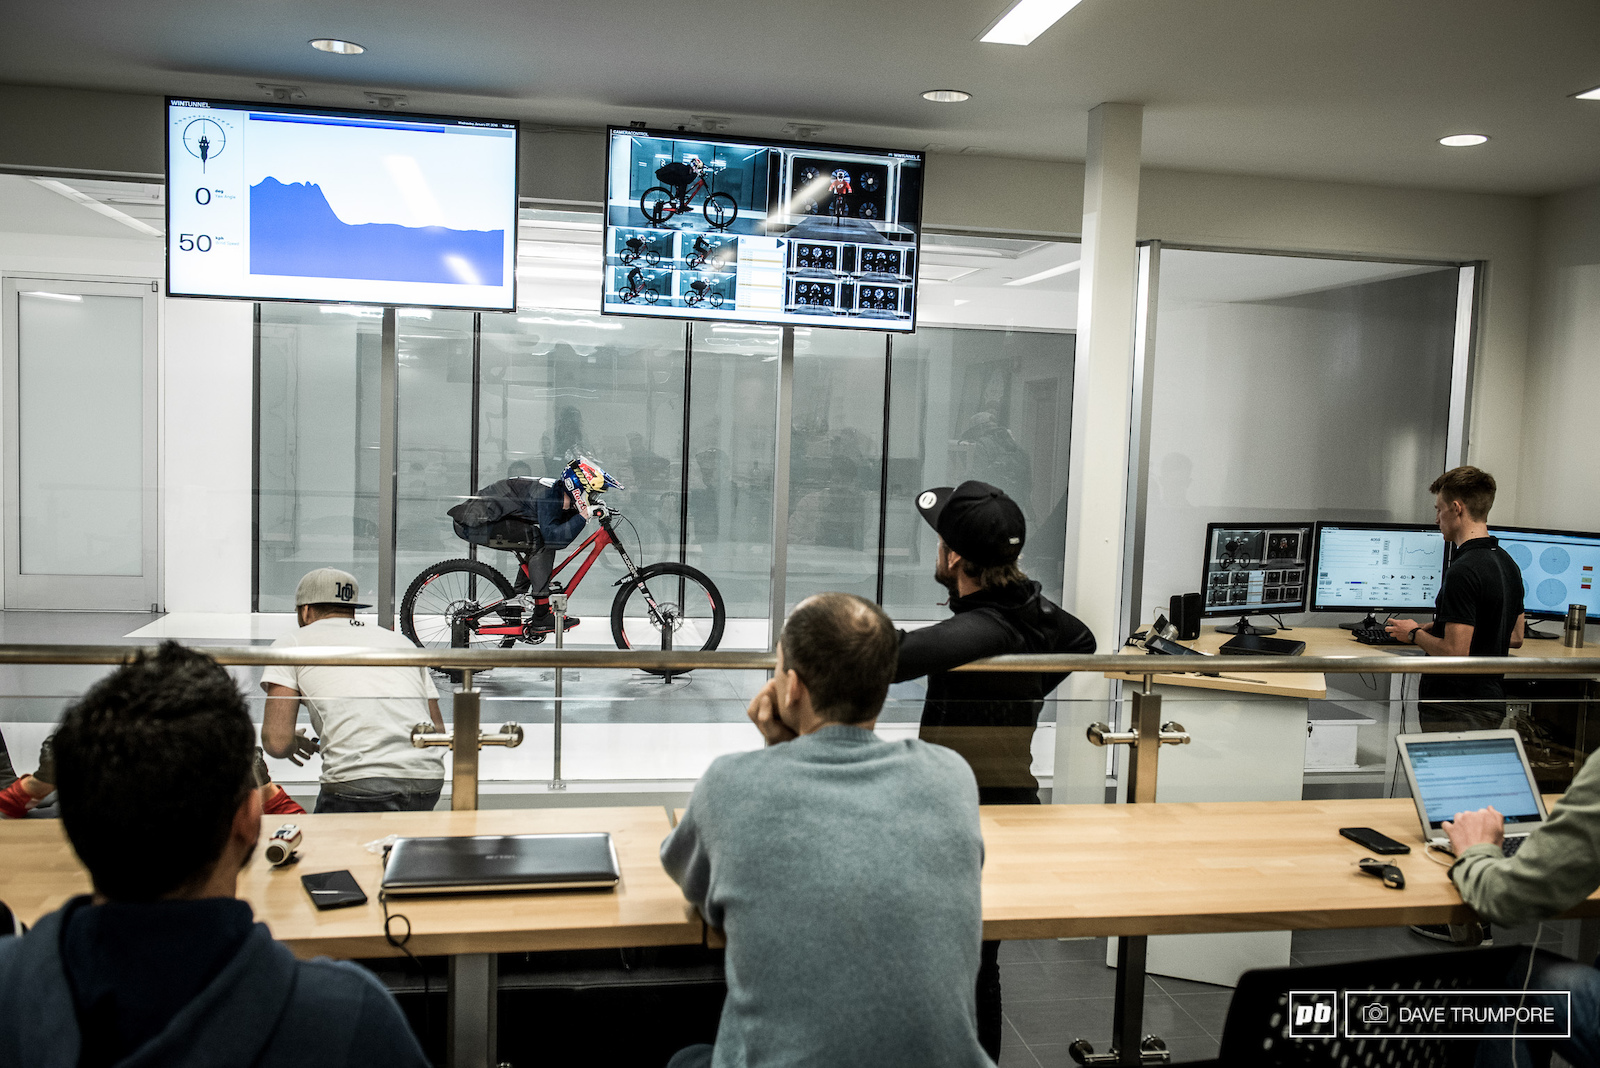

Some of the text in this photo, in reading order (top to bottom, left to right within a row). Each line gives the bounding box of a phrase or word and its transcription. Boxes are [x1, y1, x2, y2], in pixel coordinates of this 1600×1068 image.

[170, 100, 210, 108] WINTUNNEL
[195, 187, 211, 206] 0
[179, 233, 212, 252] 50
